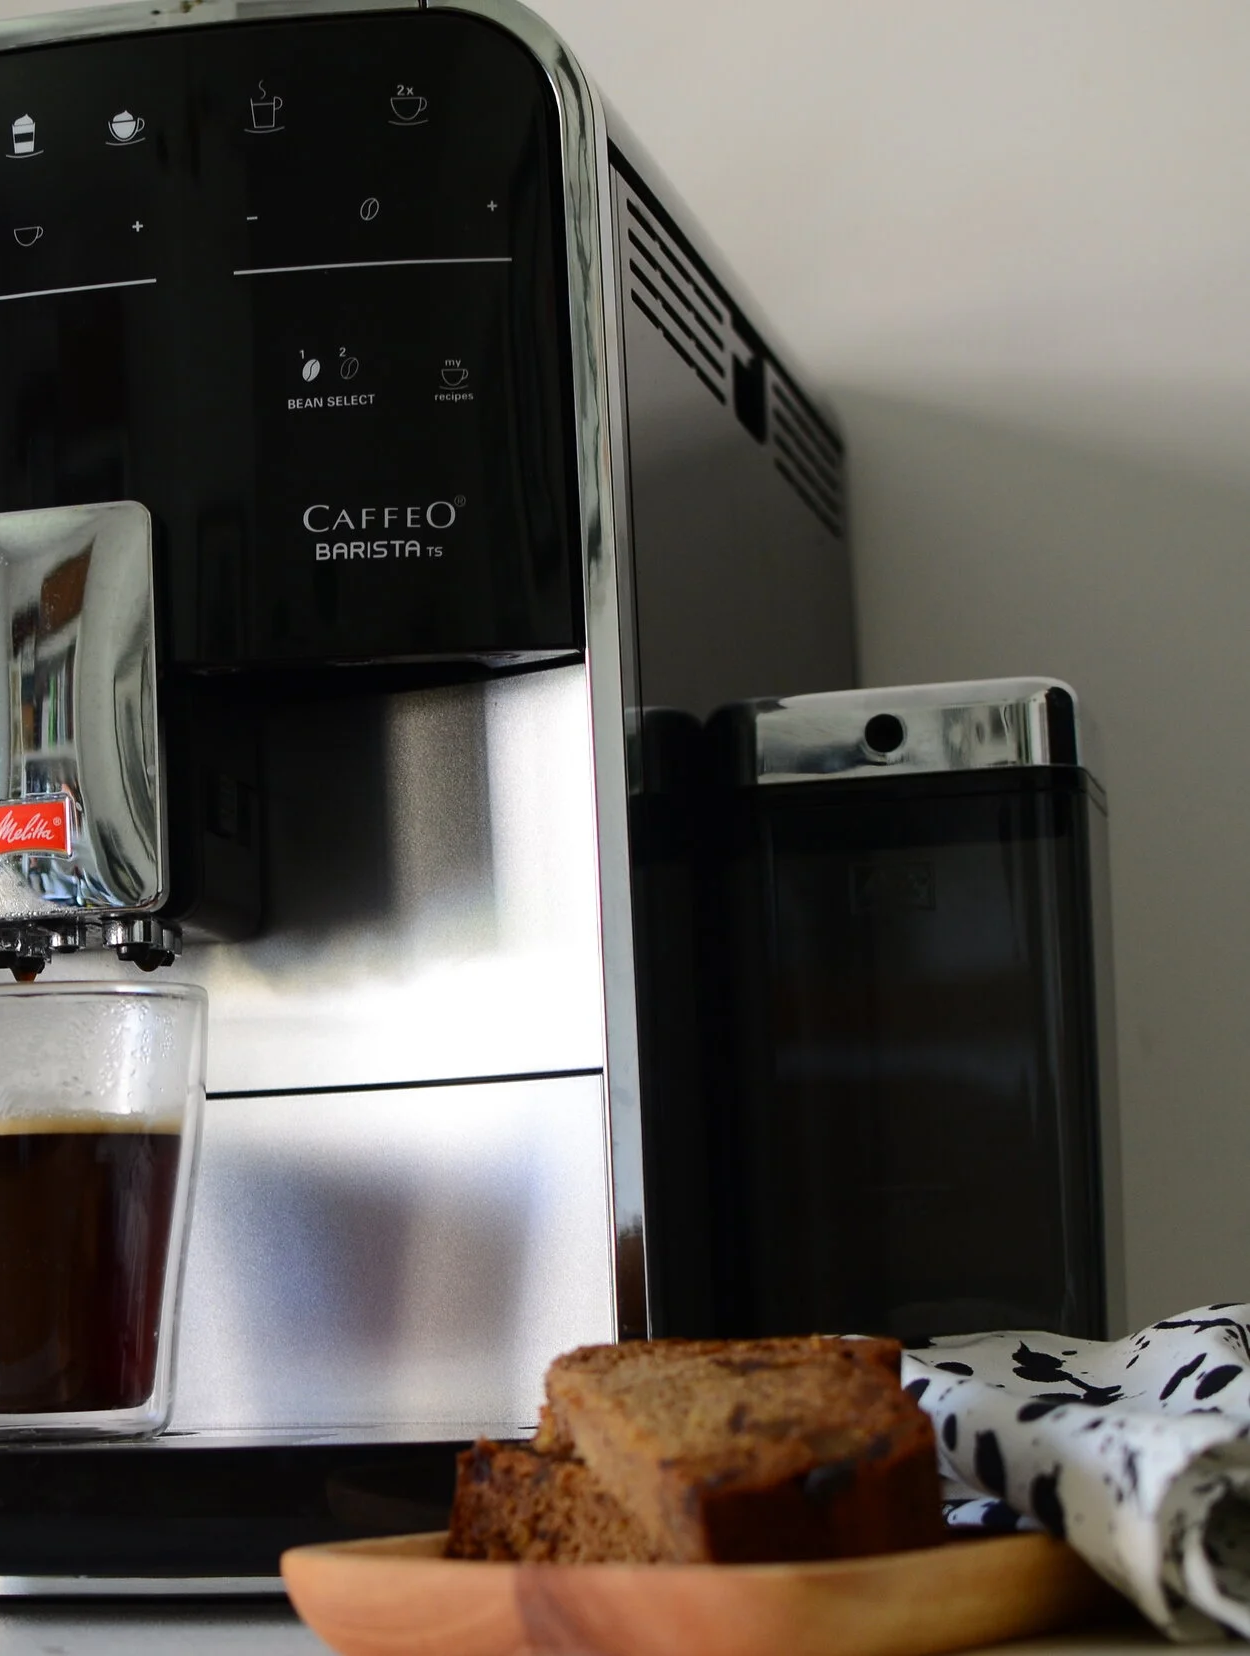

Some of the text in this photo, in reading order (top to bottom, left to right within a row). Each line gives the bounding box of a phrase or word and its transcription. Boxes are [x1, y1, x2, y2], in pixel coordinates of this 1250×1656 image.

[299, 347, 347, 360] 1 2
[445, 359, 462, 368] my
[287, 394, 376, 410] BEAN SELECT
[434, 392, 474, 403] recipes
[315, 540, 443, 561] BARISTA TS
